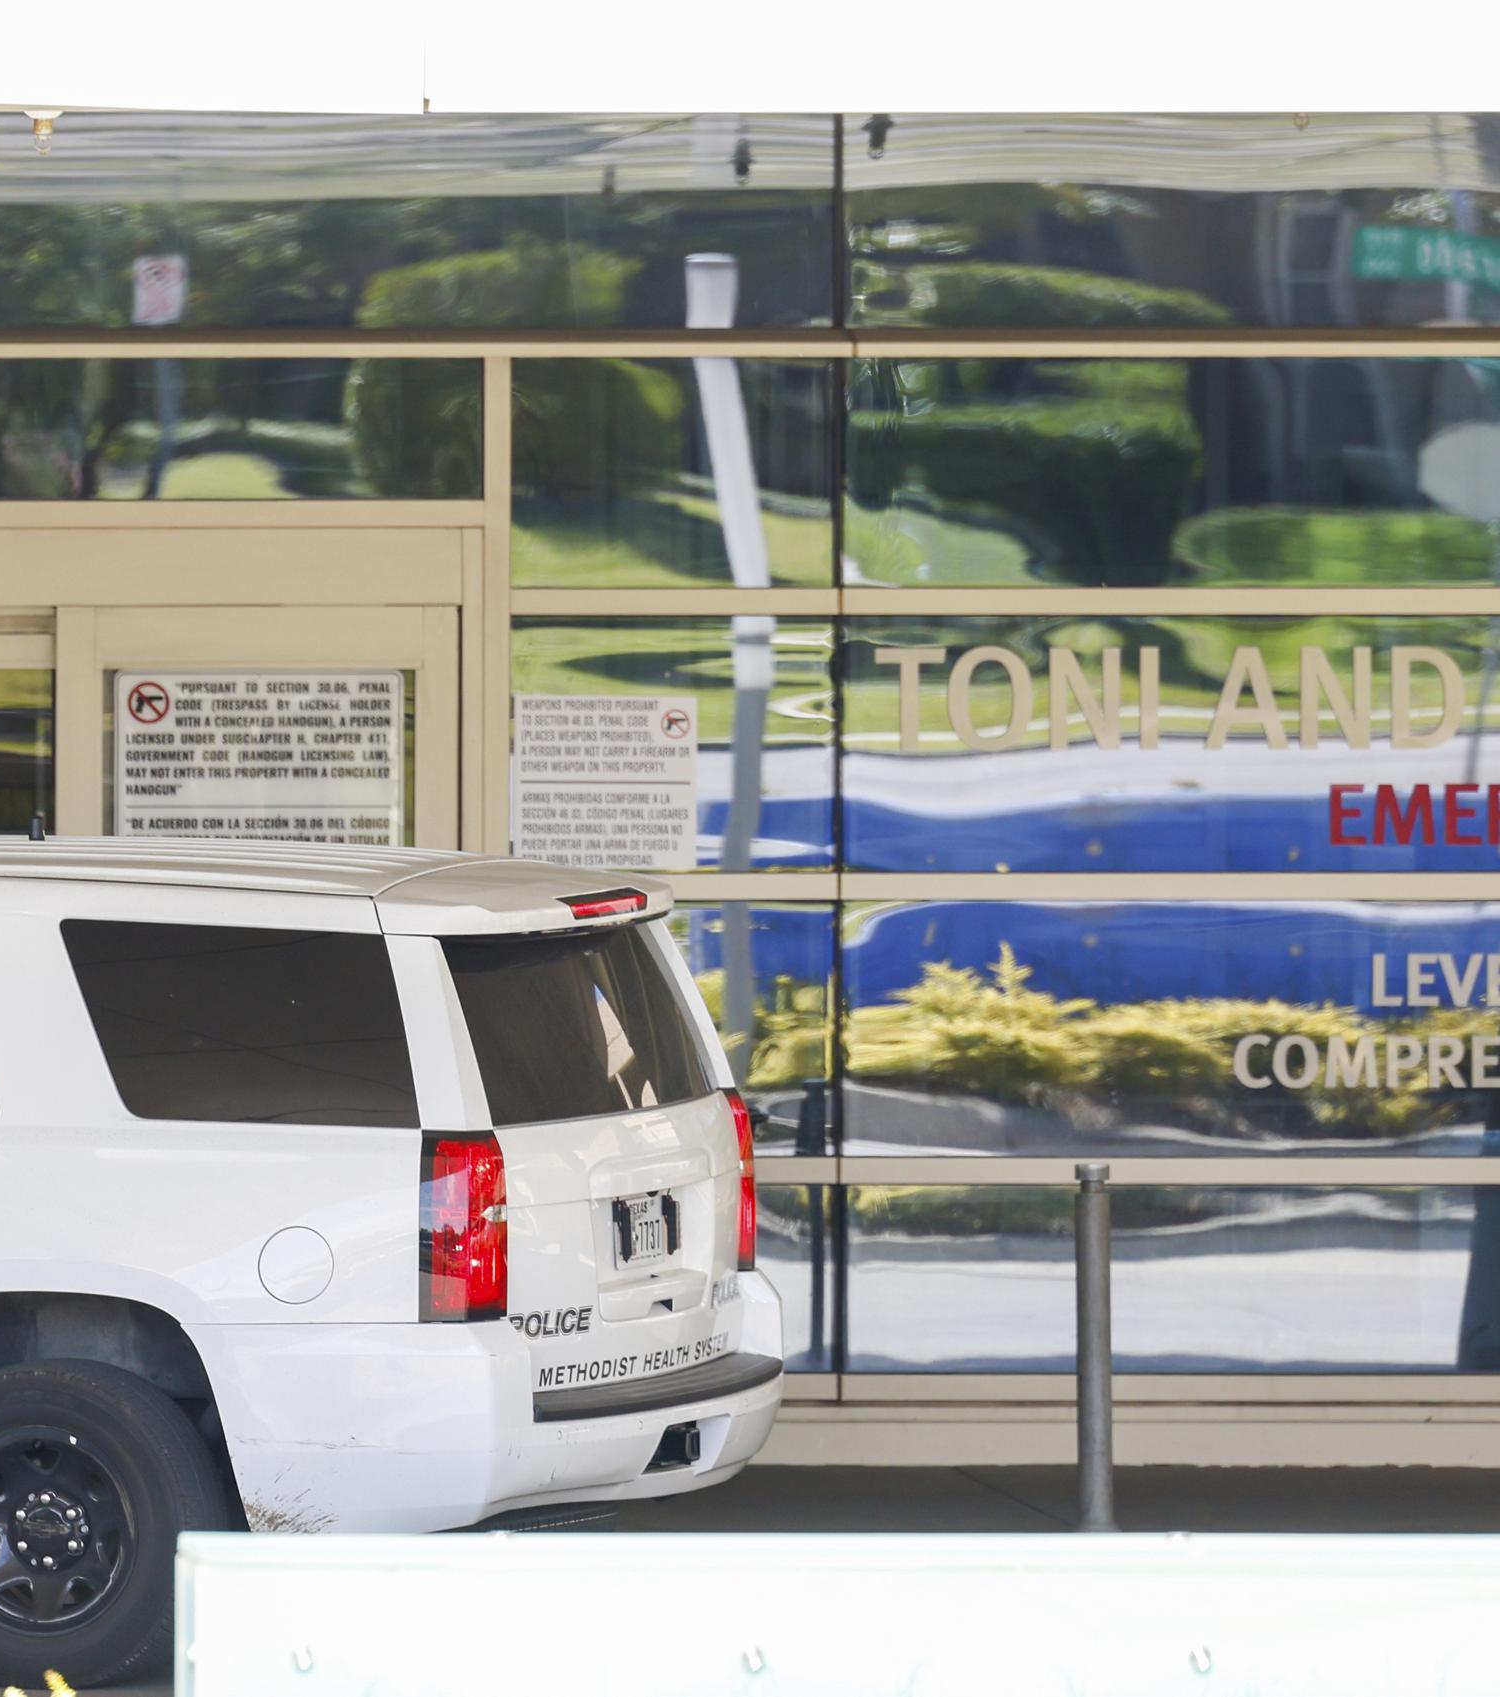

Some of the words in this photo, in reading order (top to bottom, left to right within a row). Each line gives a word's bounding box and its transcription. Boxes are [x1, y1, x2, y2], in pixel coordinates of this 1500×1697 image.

[245, 682, 258, 694] TO
[266, 682, 309, 694] SECTION
[359, 682, 390, 694] PENAL
[875, 645, 1159, 752] TONI
[1204, 645, 1466, 752] AND
[175, 699, 202, 711] CODE
[277, 699, 290, 711] BY
[349, 699, 390, 711] HOLDER
[175, 717, 201, 728] WITH
[205, 717, 211, 728] A
[340, 717, 346, 728] A
[349, 717, 390, 728] PERSON
[126, 733, 175, 744] LICENSED
[180, 733, 216, 744] UNDER
[314, 733, 361, 744] CHAPTER
[125, 750, 195, 762] GOVERNMENT
[203, 750, 229, 762] CODE
[301, 750, 354, 762] LICENSING
[125, 767, 147, 778] MAY
[150, 767, 170, 778] NOT
[173, 767, 204, 778] ENTER
[208, 767, 231, 778] THIS
[234, 767, 288, 778] PROPERTY
[292, 767, 318, 778] WITH
[321, 767, 327, 778] A
[330, 767, 390, 778] CONCEALED
[508, 1305, 593, 1340] POLICE
[538, 1356, 637, 1387] METHODIST
[643, 1347, 689, 1373] HEALTH
[695, 1332, 729, 1362] SYSTEM
